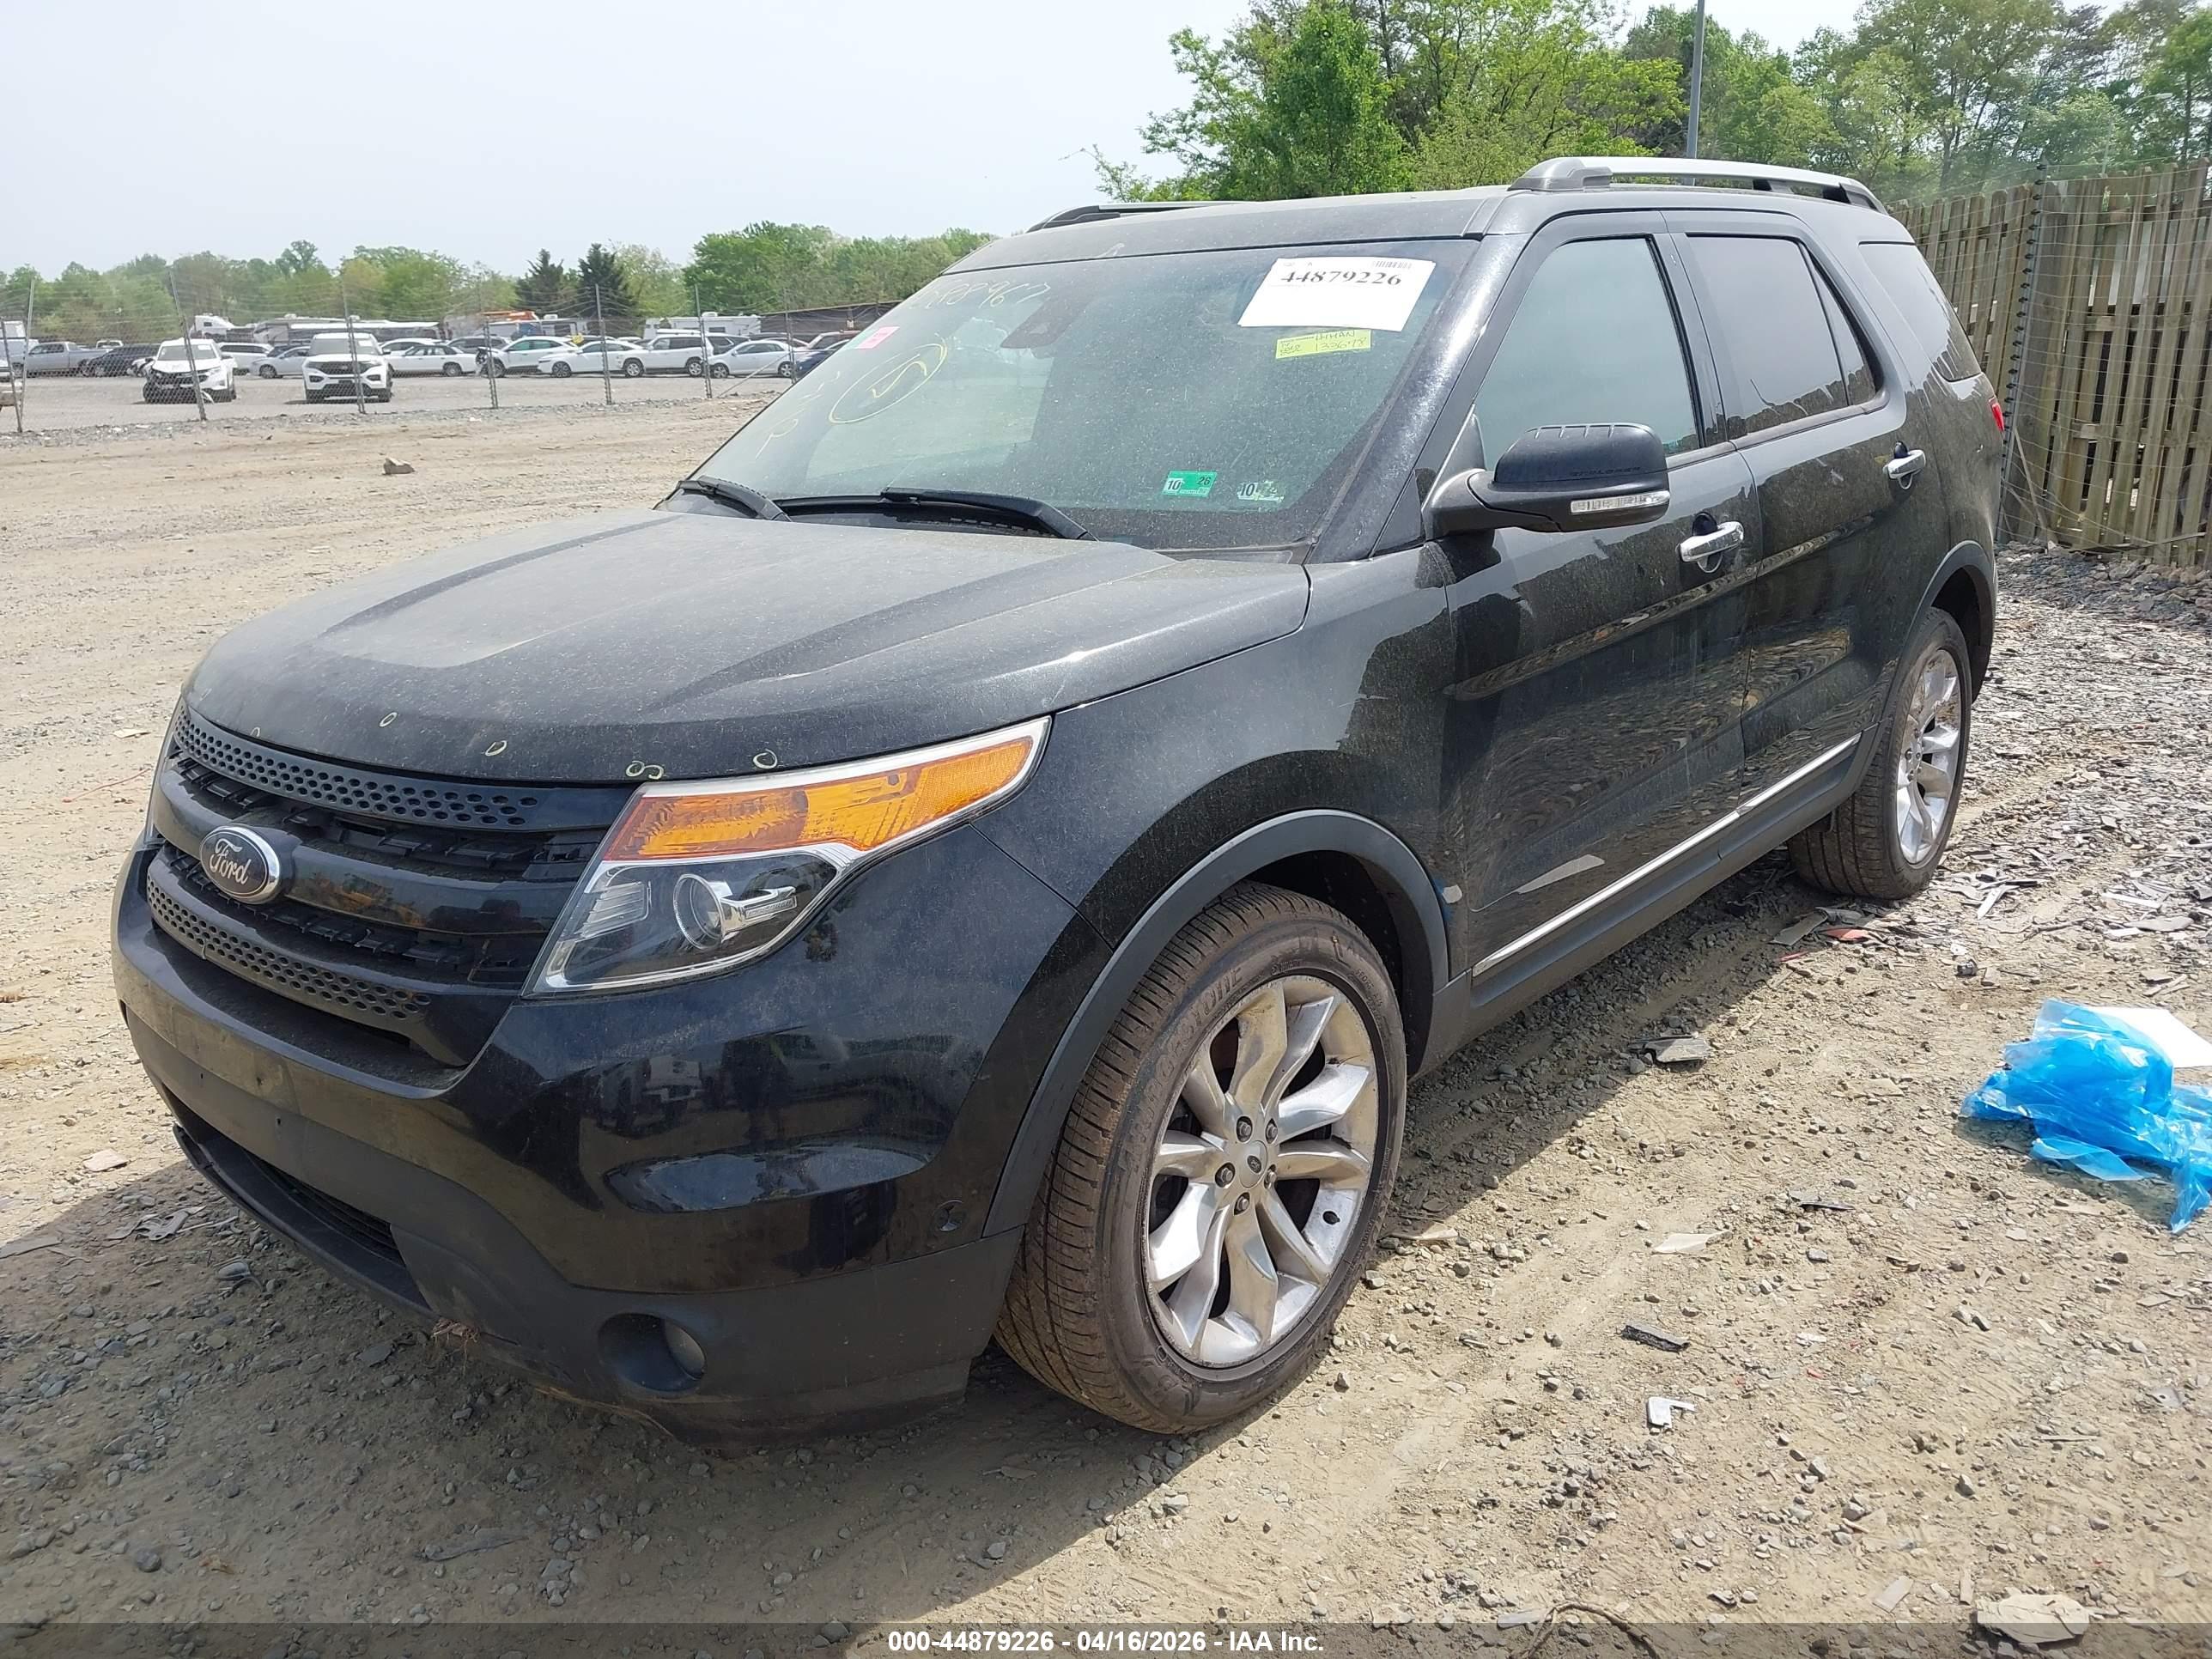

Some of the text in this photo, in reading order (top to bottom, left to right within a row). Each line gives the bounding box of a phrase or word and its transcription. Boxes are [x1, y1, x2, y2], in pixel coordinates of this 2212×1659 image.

[1280, 270, 1402, 286] 44879226
[1167, 477, 1212, 490] 10 26
[1240, 483, 1255, 496] 10
[210, 838, 252, 884] Ford
